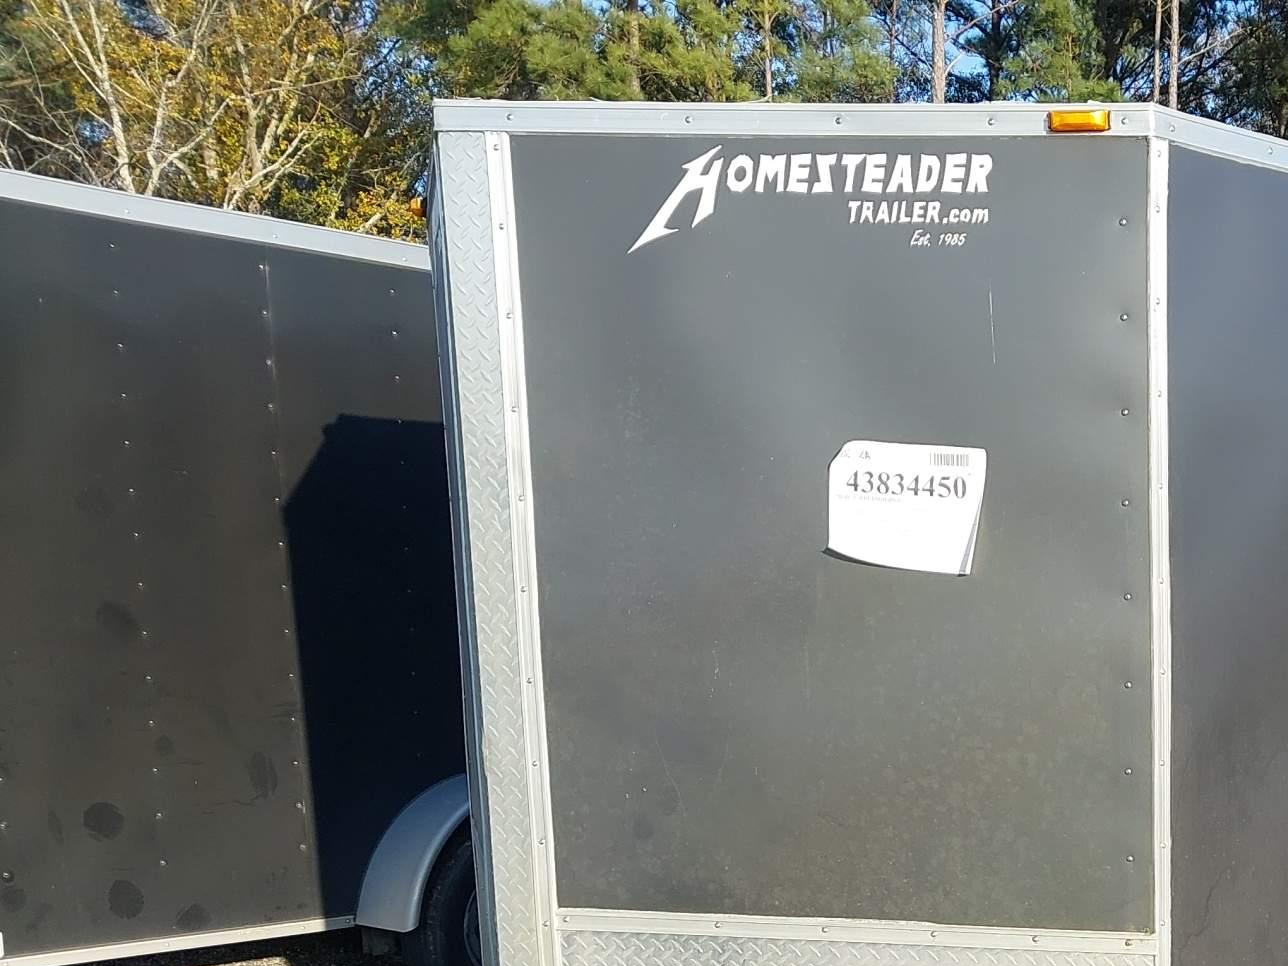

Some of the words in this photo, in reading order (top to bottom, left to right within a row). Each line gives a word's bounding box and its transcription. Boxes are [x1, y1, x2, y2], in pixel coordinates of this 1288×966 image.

[628, 144, 993, 254] HOMESTEADER
[847, 200, 990, 225] TRAILER.com
[936, 230, 968, 248] 1985
[846, 469, 967, 500] 43834450
